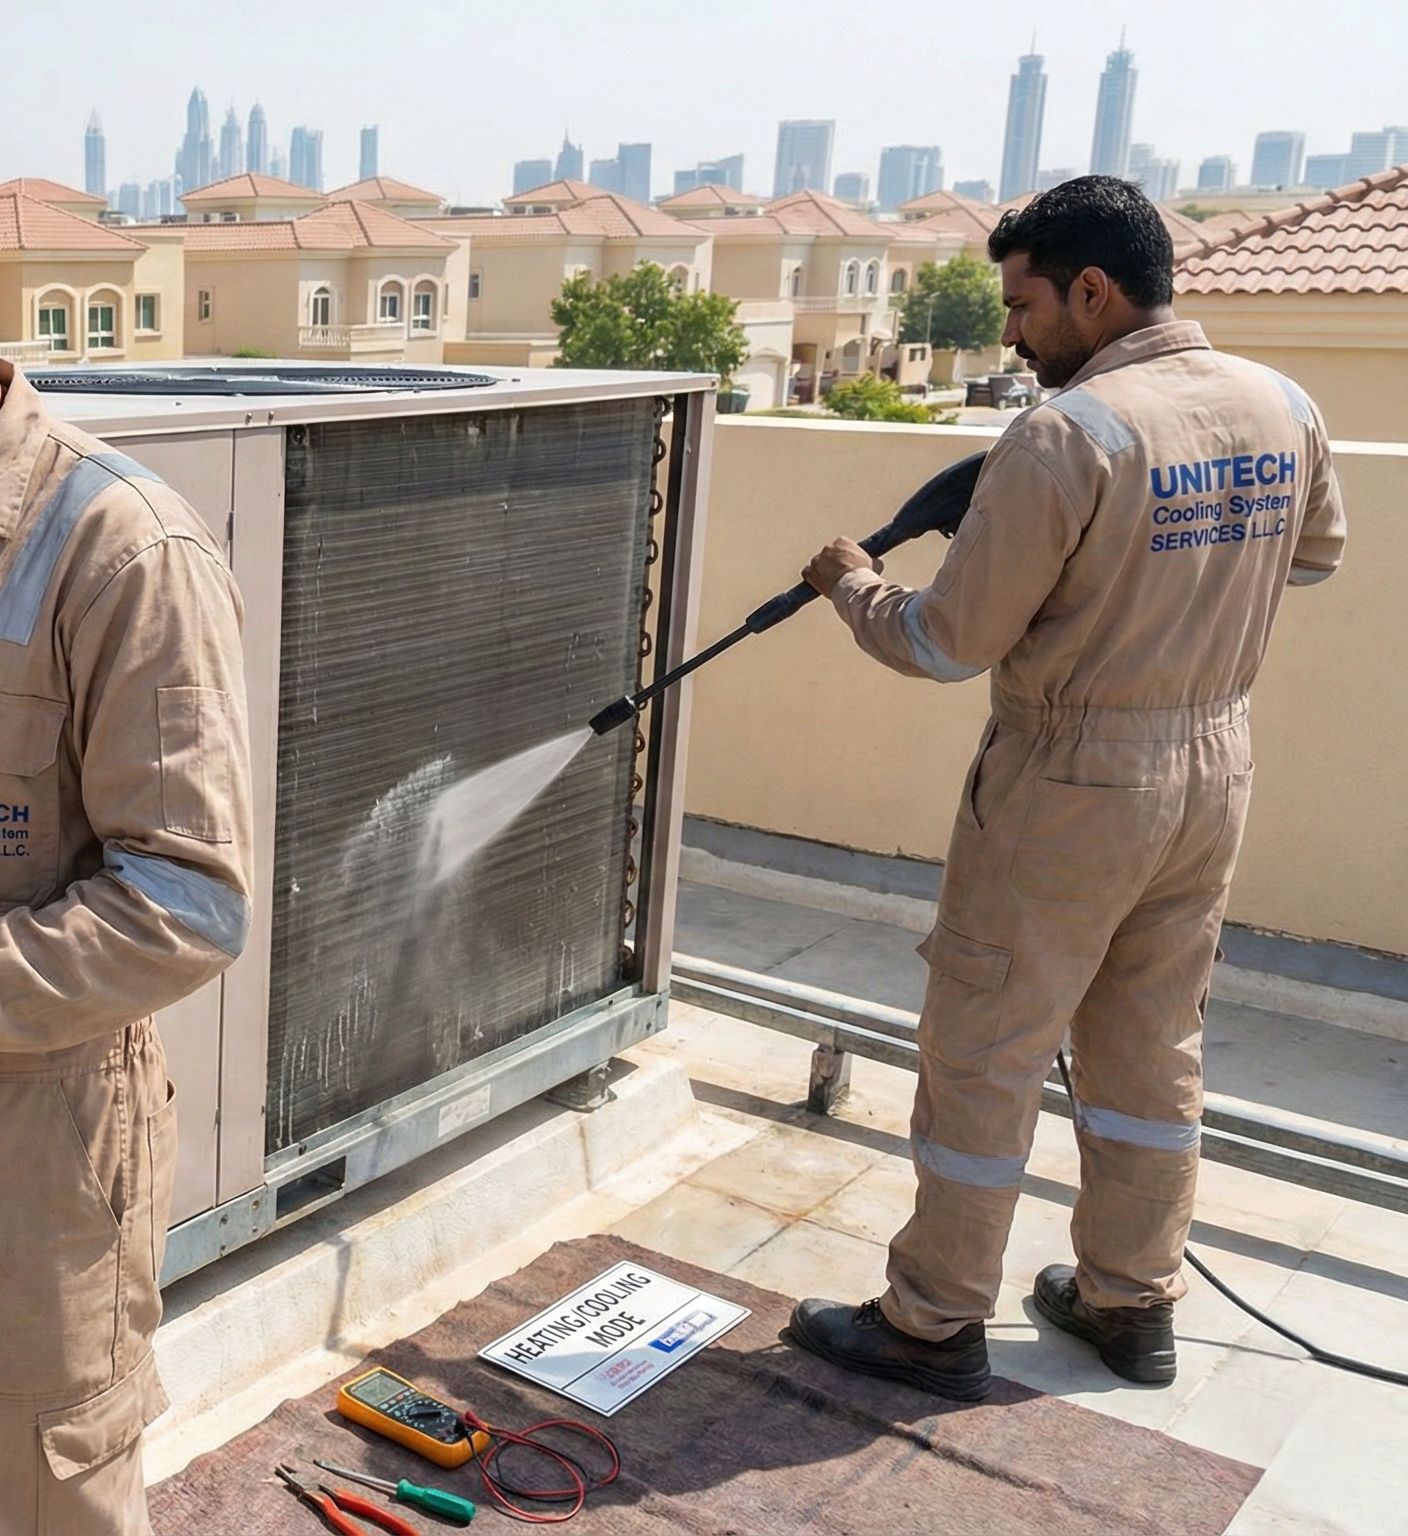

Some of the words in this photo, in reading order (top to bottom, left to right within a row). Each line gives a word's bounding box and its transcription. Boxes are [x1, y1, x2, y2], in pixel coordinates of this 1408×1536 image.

[1150, 452, 1296, 498] UNITECH
[1153, 500, 1222, 525] Cooling
[1150, 523, 1245, 552] SERVICES
[504, 1272, 652, 1364] HEATING/COOLING
[585, 1311, 647, 1348] MODE
